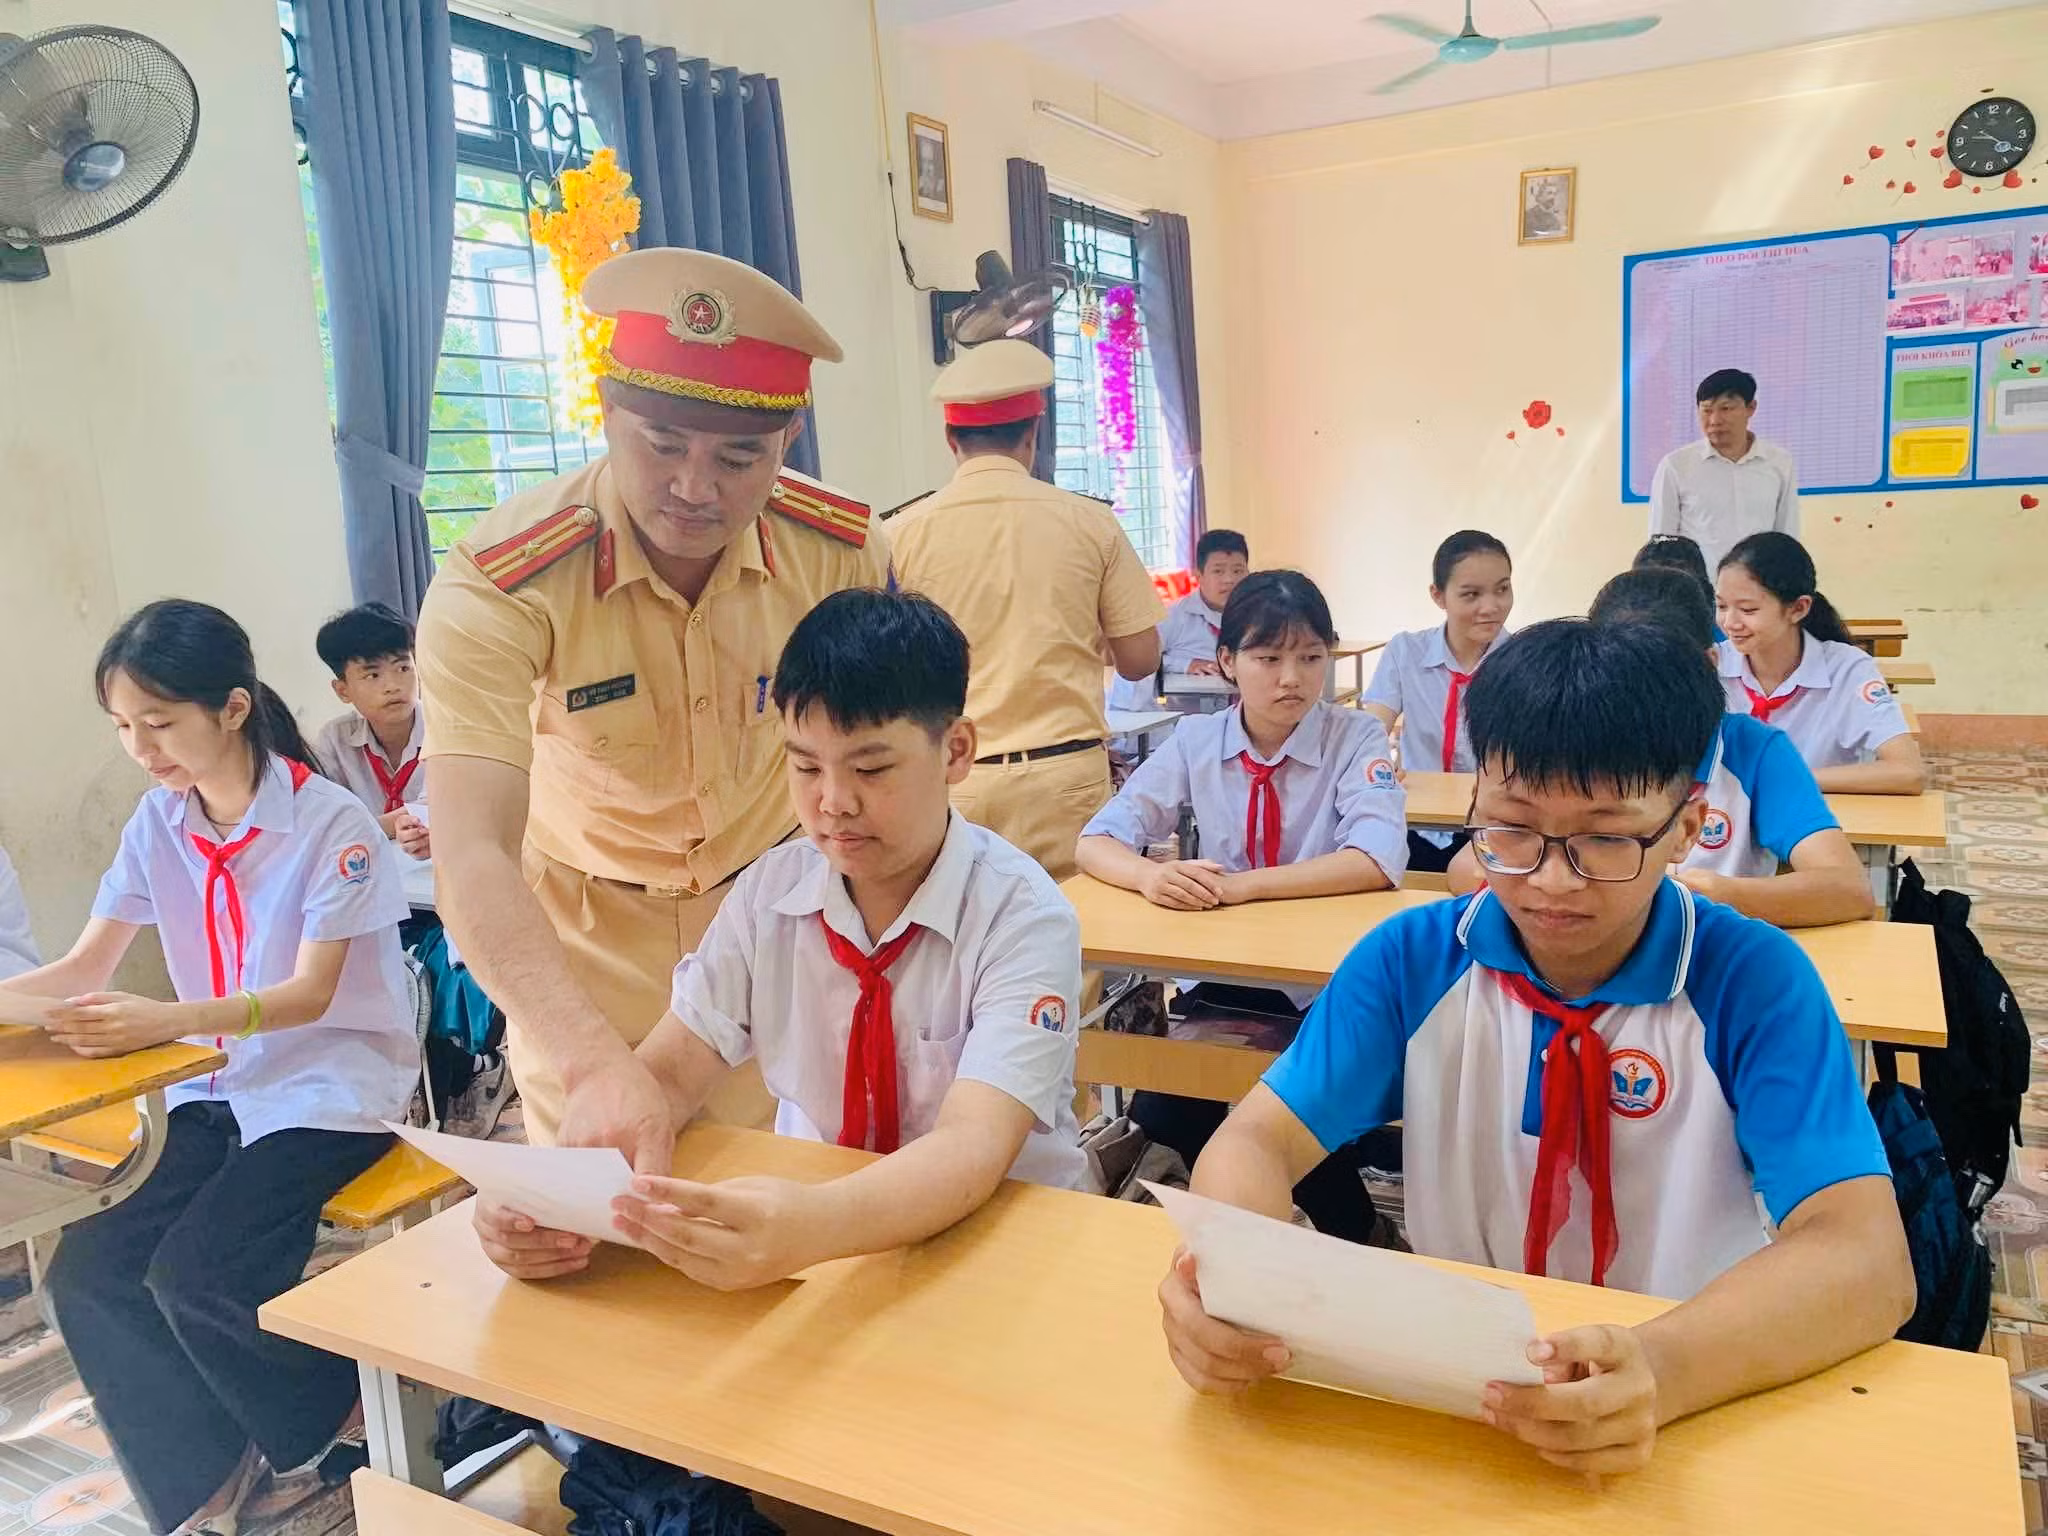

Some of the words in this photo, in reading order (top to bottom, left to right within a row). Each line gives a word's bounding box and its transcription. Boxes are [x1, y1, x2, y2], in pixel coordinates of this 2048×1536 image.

[1988, 104, 2000, 115] 12
[2018, 129, 2027, 139] 3
[1955, 137, 1964, 147] 9
[1985, 161, 1994, 171] 6
